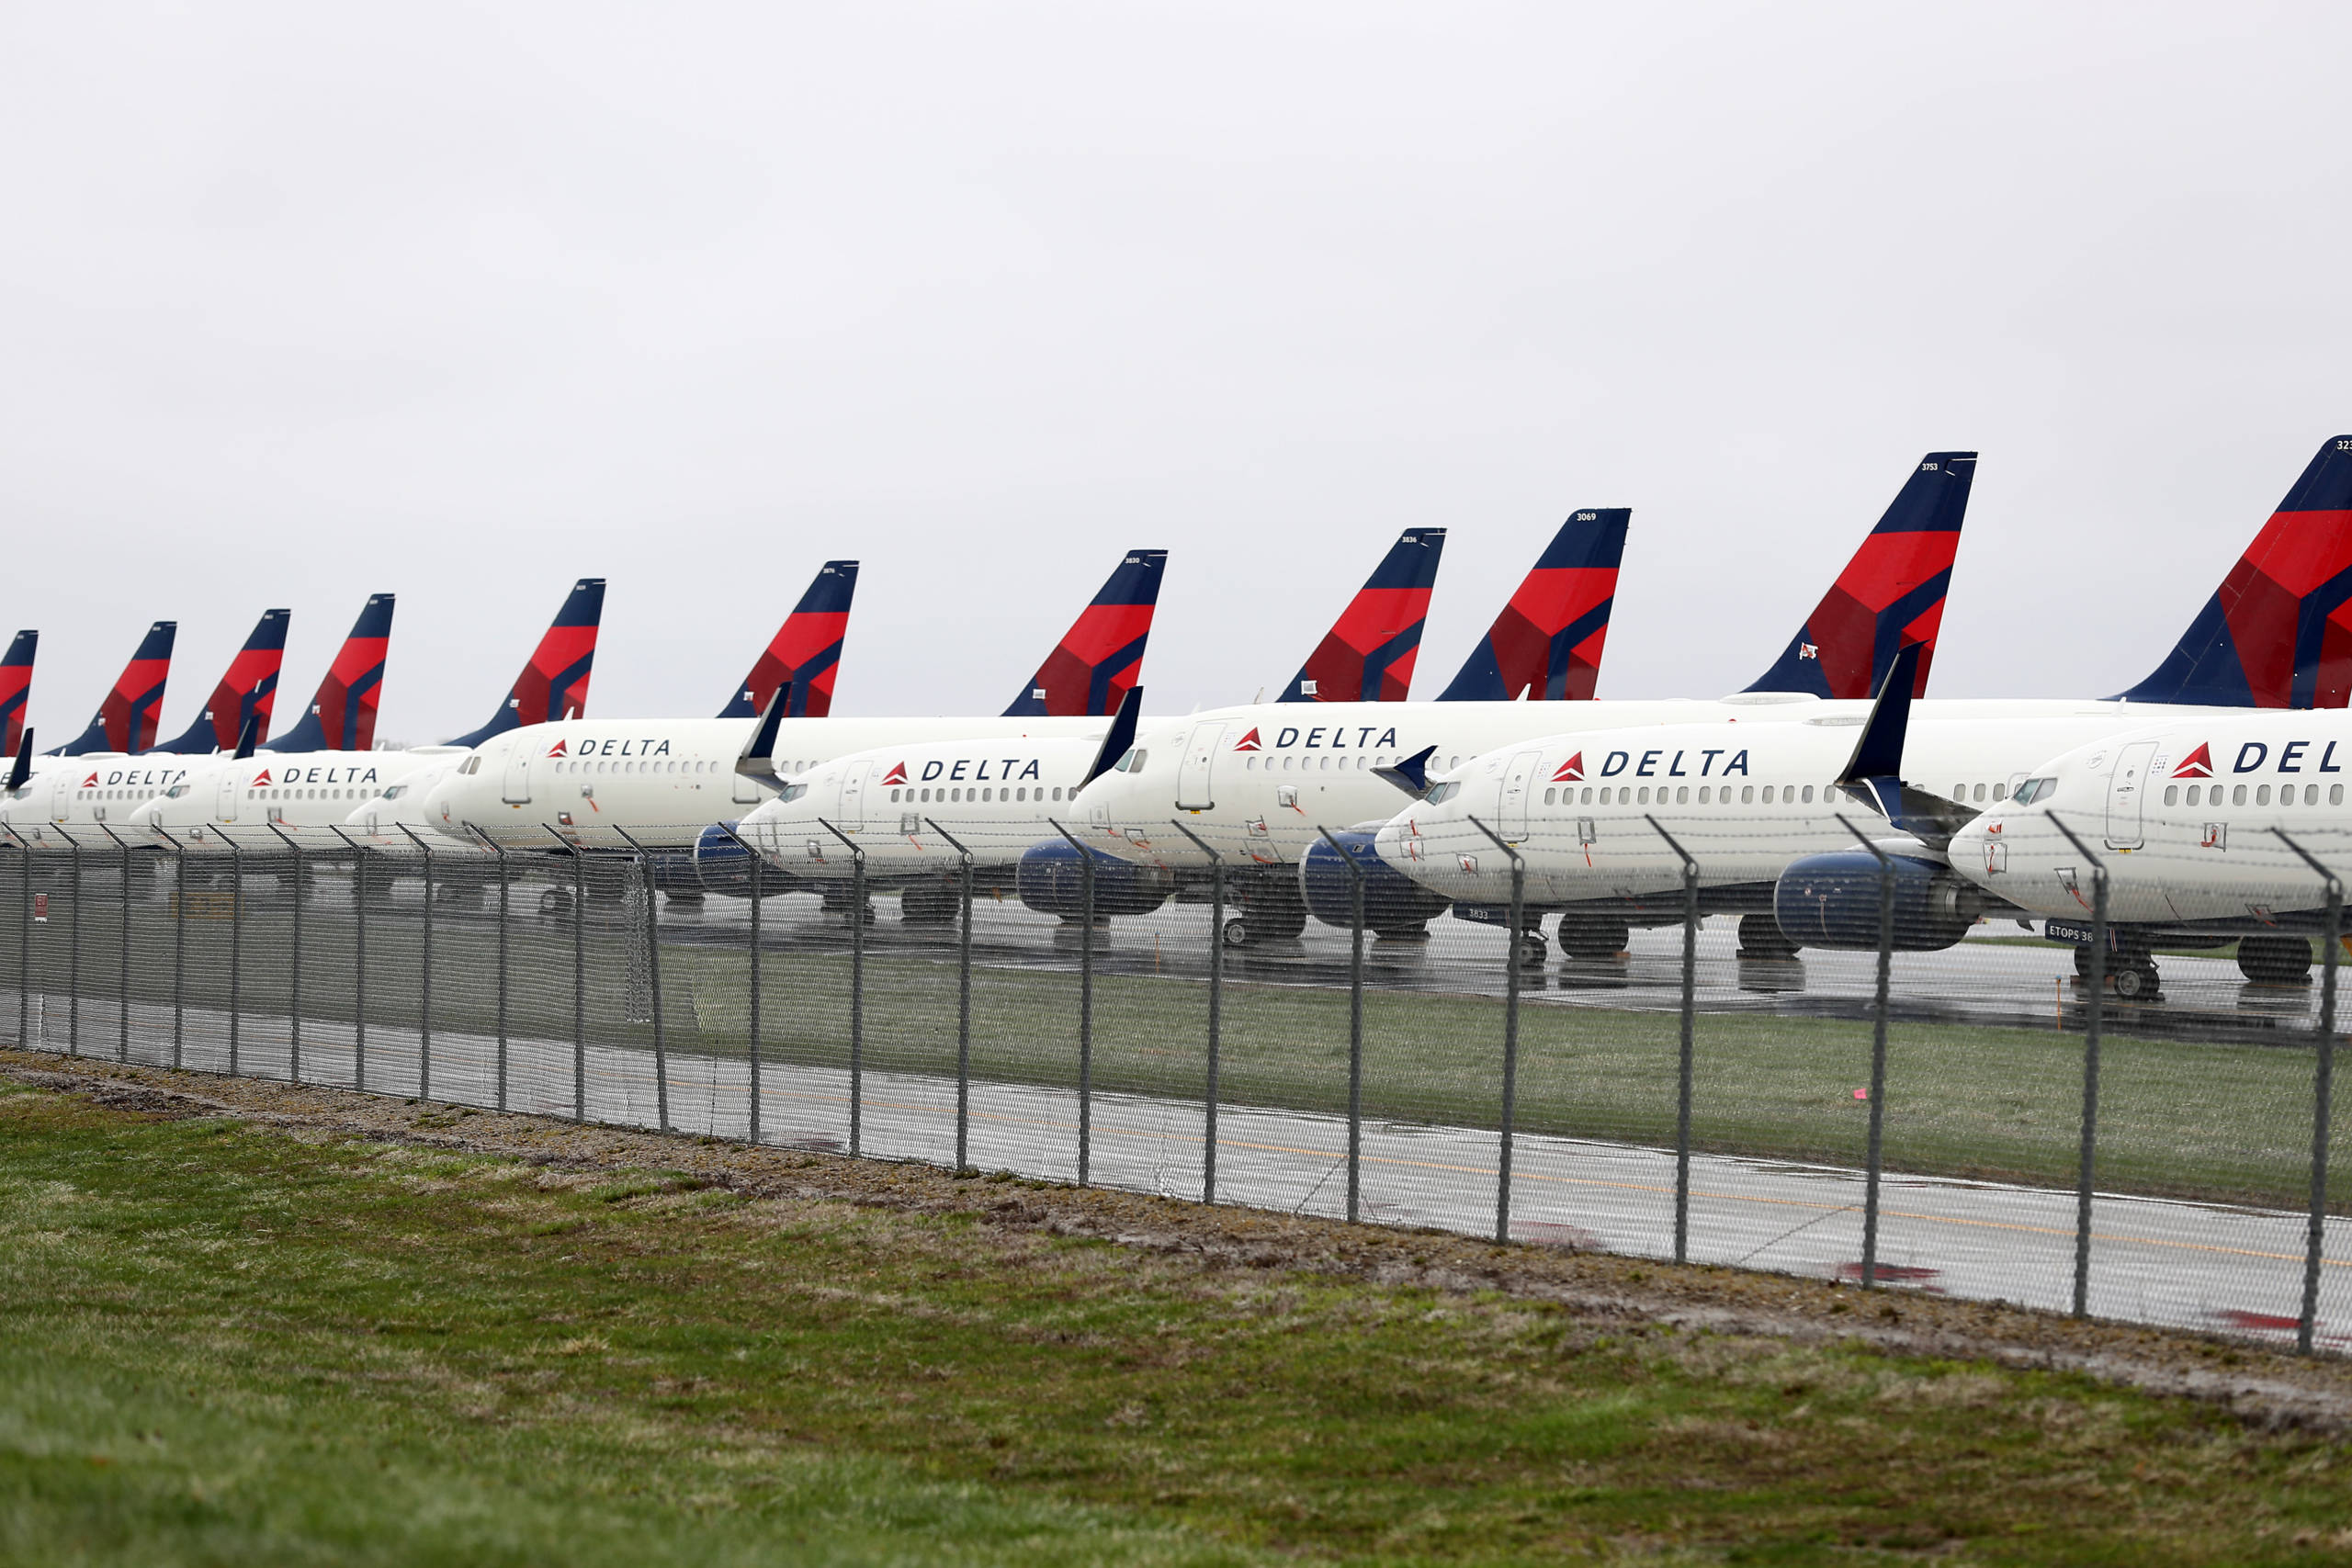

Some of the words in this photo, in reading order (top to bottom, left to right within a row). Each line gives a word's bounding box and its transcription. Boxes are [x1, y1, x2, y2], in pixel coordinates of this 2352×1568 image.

[1922, 463, 1938, 471] 3753
[1577, 513, 1596, 521] 3069
[1275, 728, 1396, 749] DELTA
[578, 739, 670, 756] DELTA
[1600, 749, 1748, 777] DELTA
[2233, 740, 2342, 773] DEL
[107, 770, 187, 785] DELTA
[283, 767, 377, 784] DELTA
[921, 759, 1040, 781] DELTA
[2050, 925, 2080, 941] ETOPS
